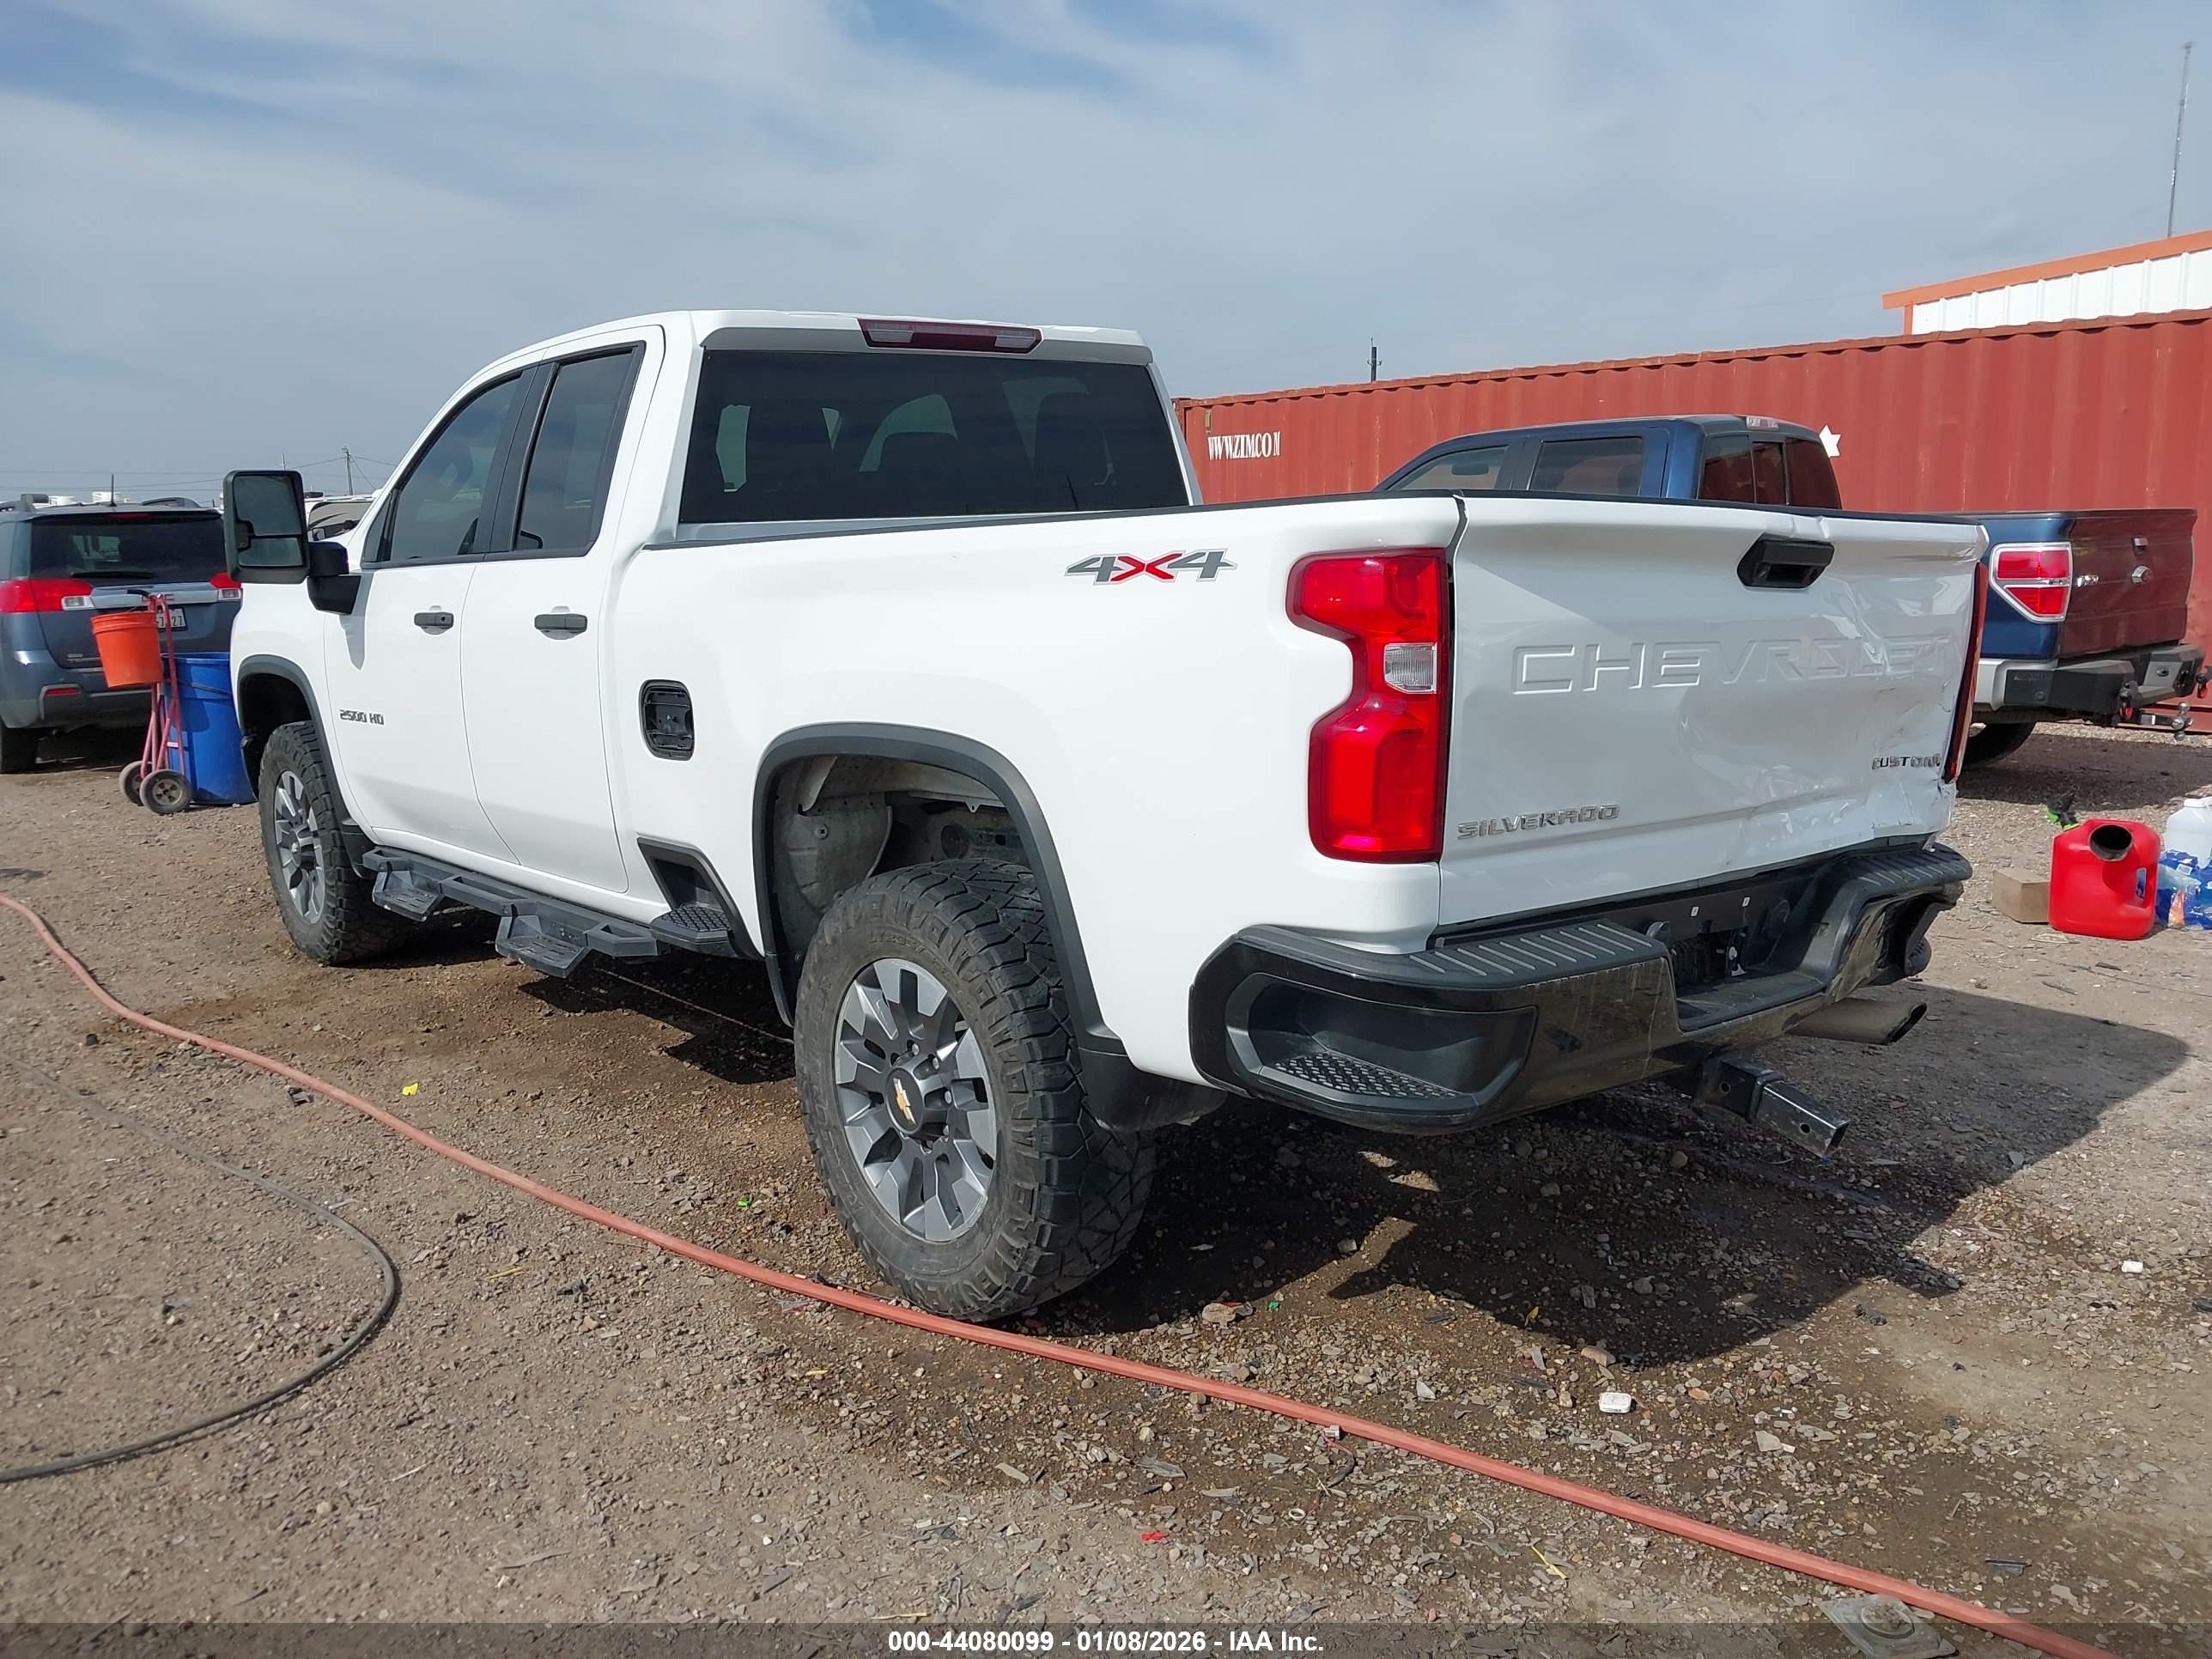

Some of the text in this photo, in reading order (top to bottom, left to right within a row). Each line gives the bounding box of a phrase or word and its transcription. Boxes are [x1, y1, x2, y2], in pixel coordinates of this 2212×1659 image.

[1511, 633, 1962, 694] CHEVROLET
[339, 709, 384, 726] 2500 HD
[1872, 753, 1941, 770] CUSTOM
[1458, 804, 1620, 840] SILVERADO
